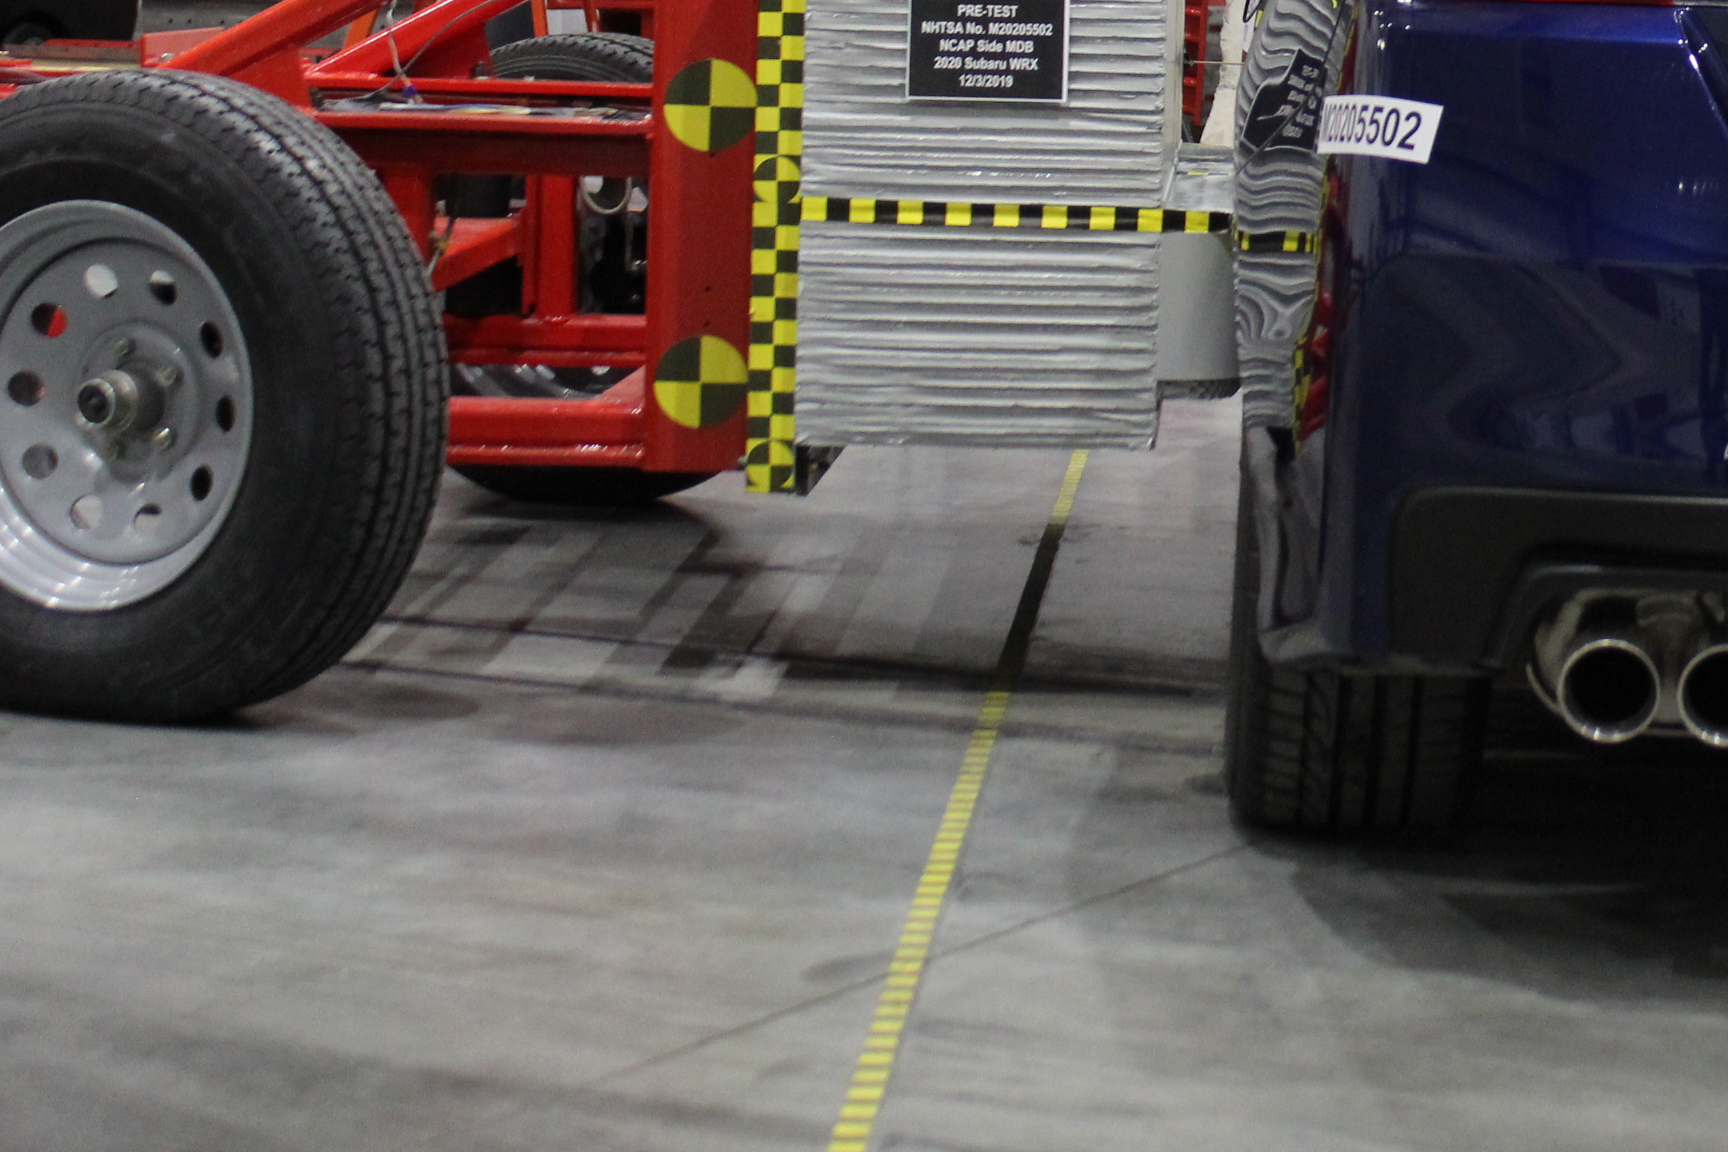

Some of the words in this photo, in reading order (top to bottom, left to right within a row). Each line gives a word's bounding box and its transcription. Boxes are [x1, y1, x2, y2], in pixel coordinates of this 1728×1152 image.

[957, 3, 1019, 18] PRE-TEST
[921, 20, 965, 35] NHTSA
[965, 21, 986, 35] No.
[987, 22, 1054, 37] M20205502
[939, 38, 975, 52] NCAP
[976, 39, 1004, 53] Side
[1005, 39, 1034, 54] MDB
[933, 55, 963, 70] 2020
[963, 56, 1008, 71] Subaru
[1008, 57, 1039, 71] WRX
[958, 73, 1014, 88] 12/3/2019
